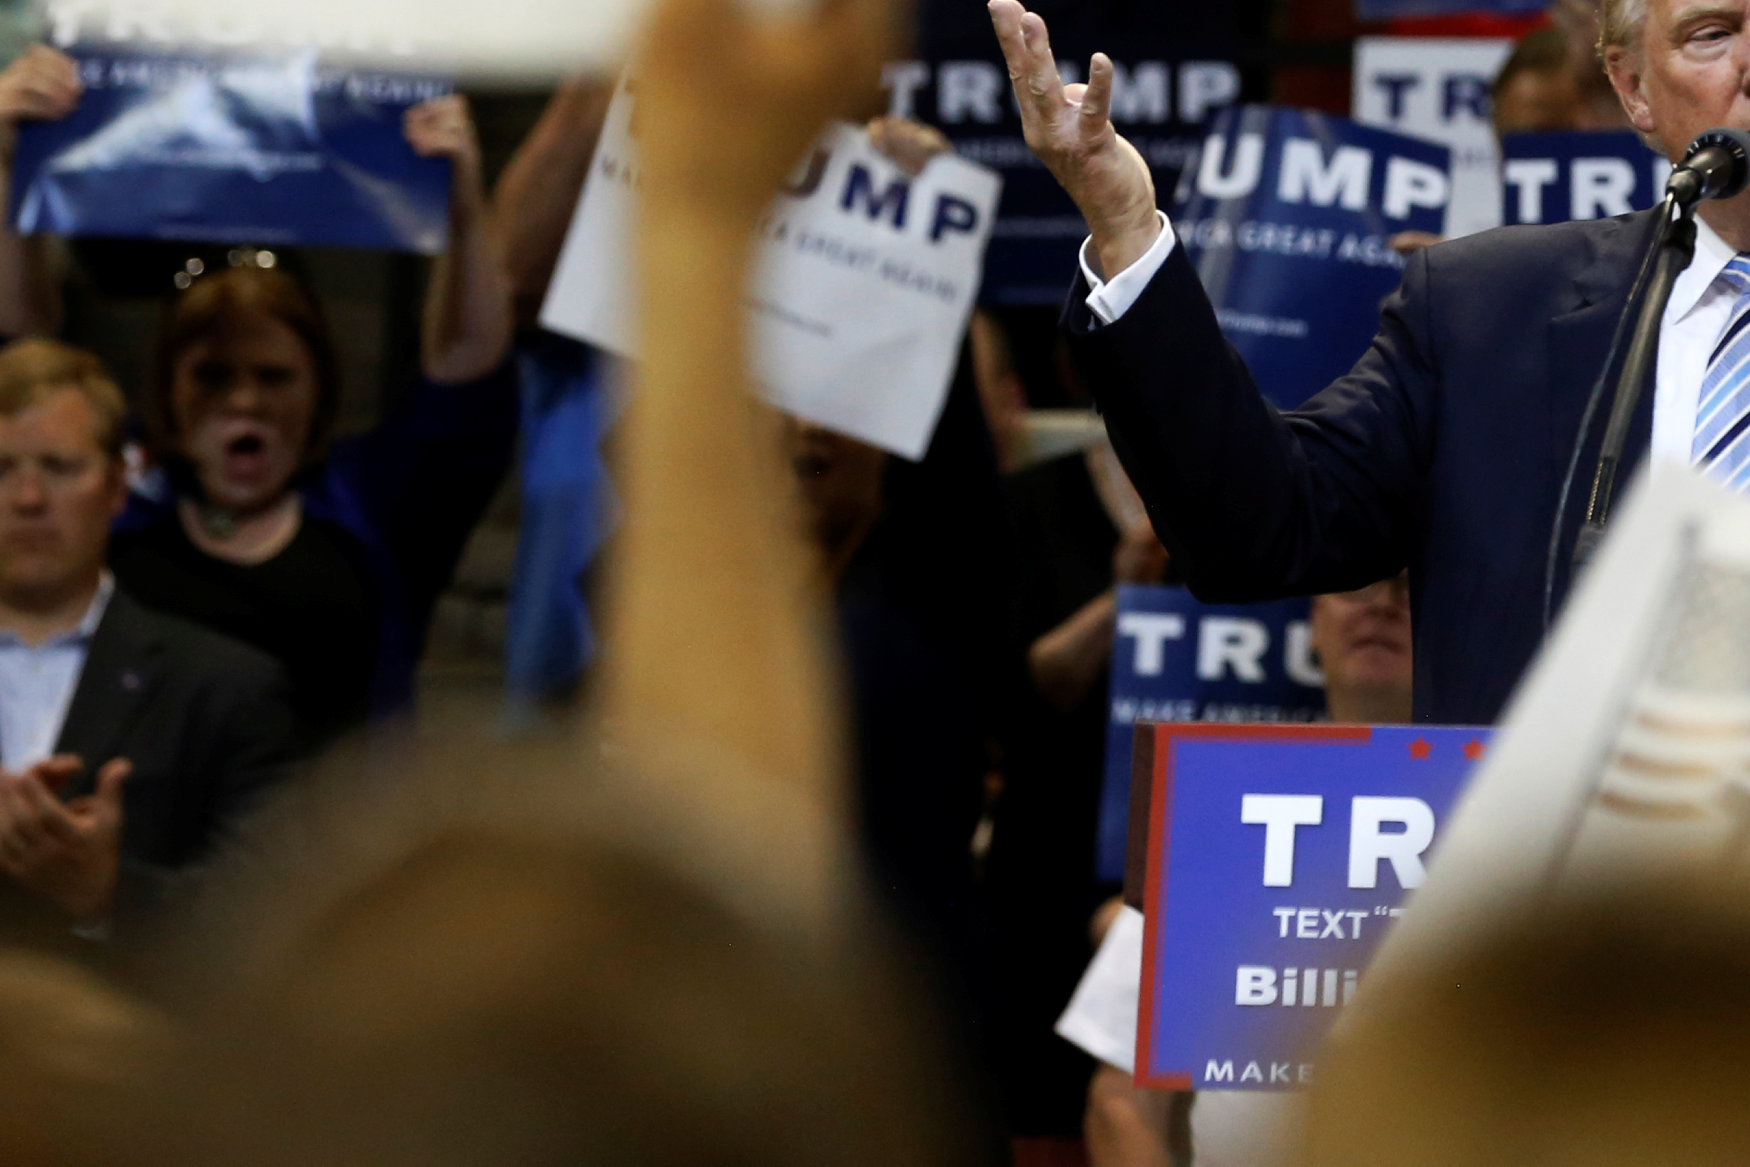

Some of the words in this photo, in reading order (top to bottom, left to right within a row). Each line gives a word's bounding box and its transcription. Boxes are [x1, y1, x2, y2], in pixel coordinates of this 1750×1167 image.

[882, 60, 1243, 124] TRMP
[776, 148, 979, 245] UMP
[1196, 131, 1449, 220] UMP
[1117, 612, 1327, 687] TRU
[1272, 906, 1370, 939] TEXT
[1234, 963, 1359, 1008] Billi
